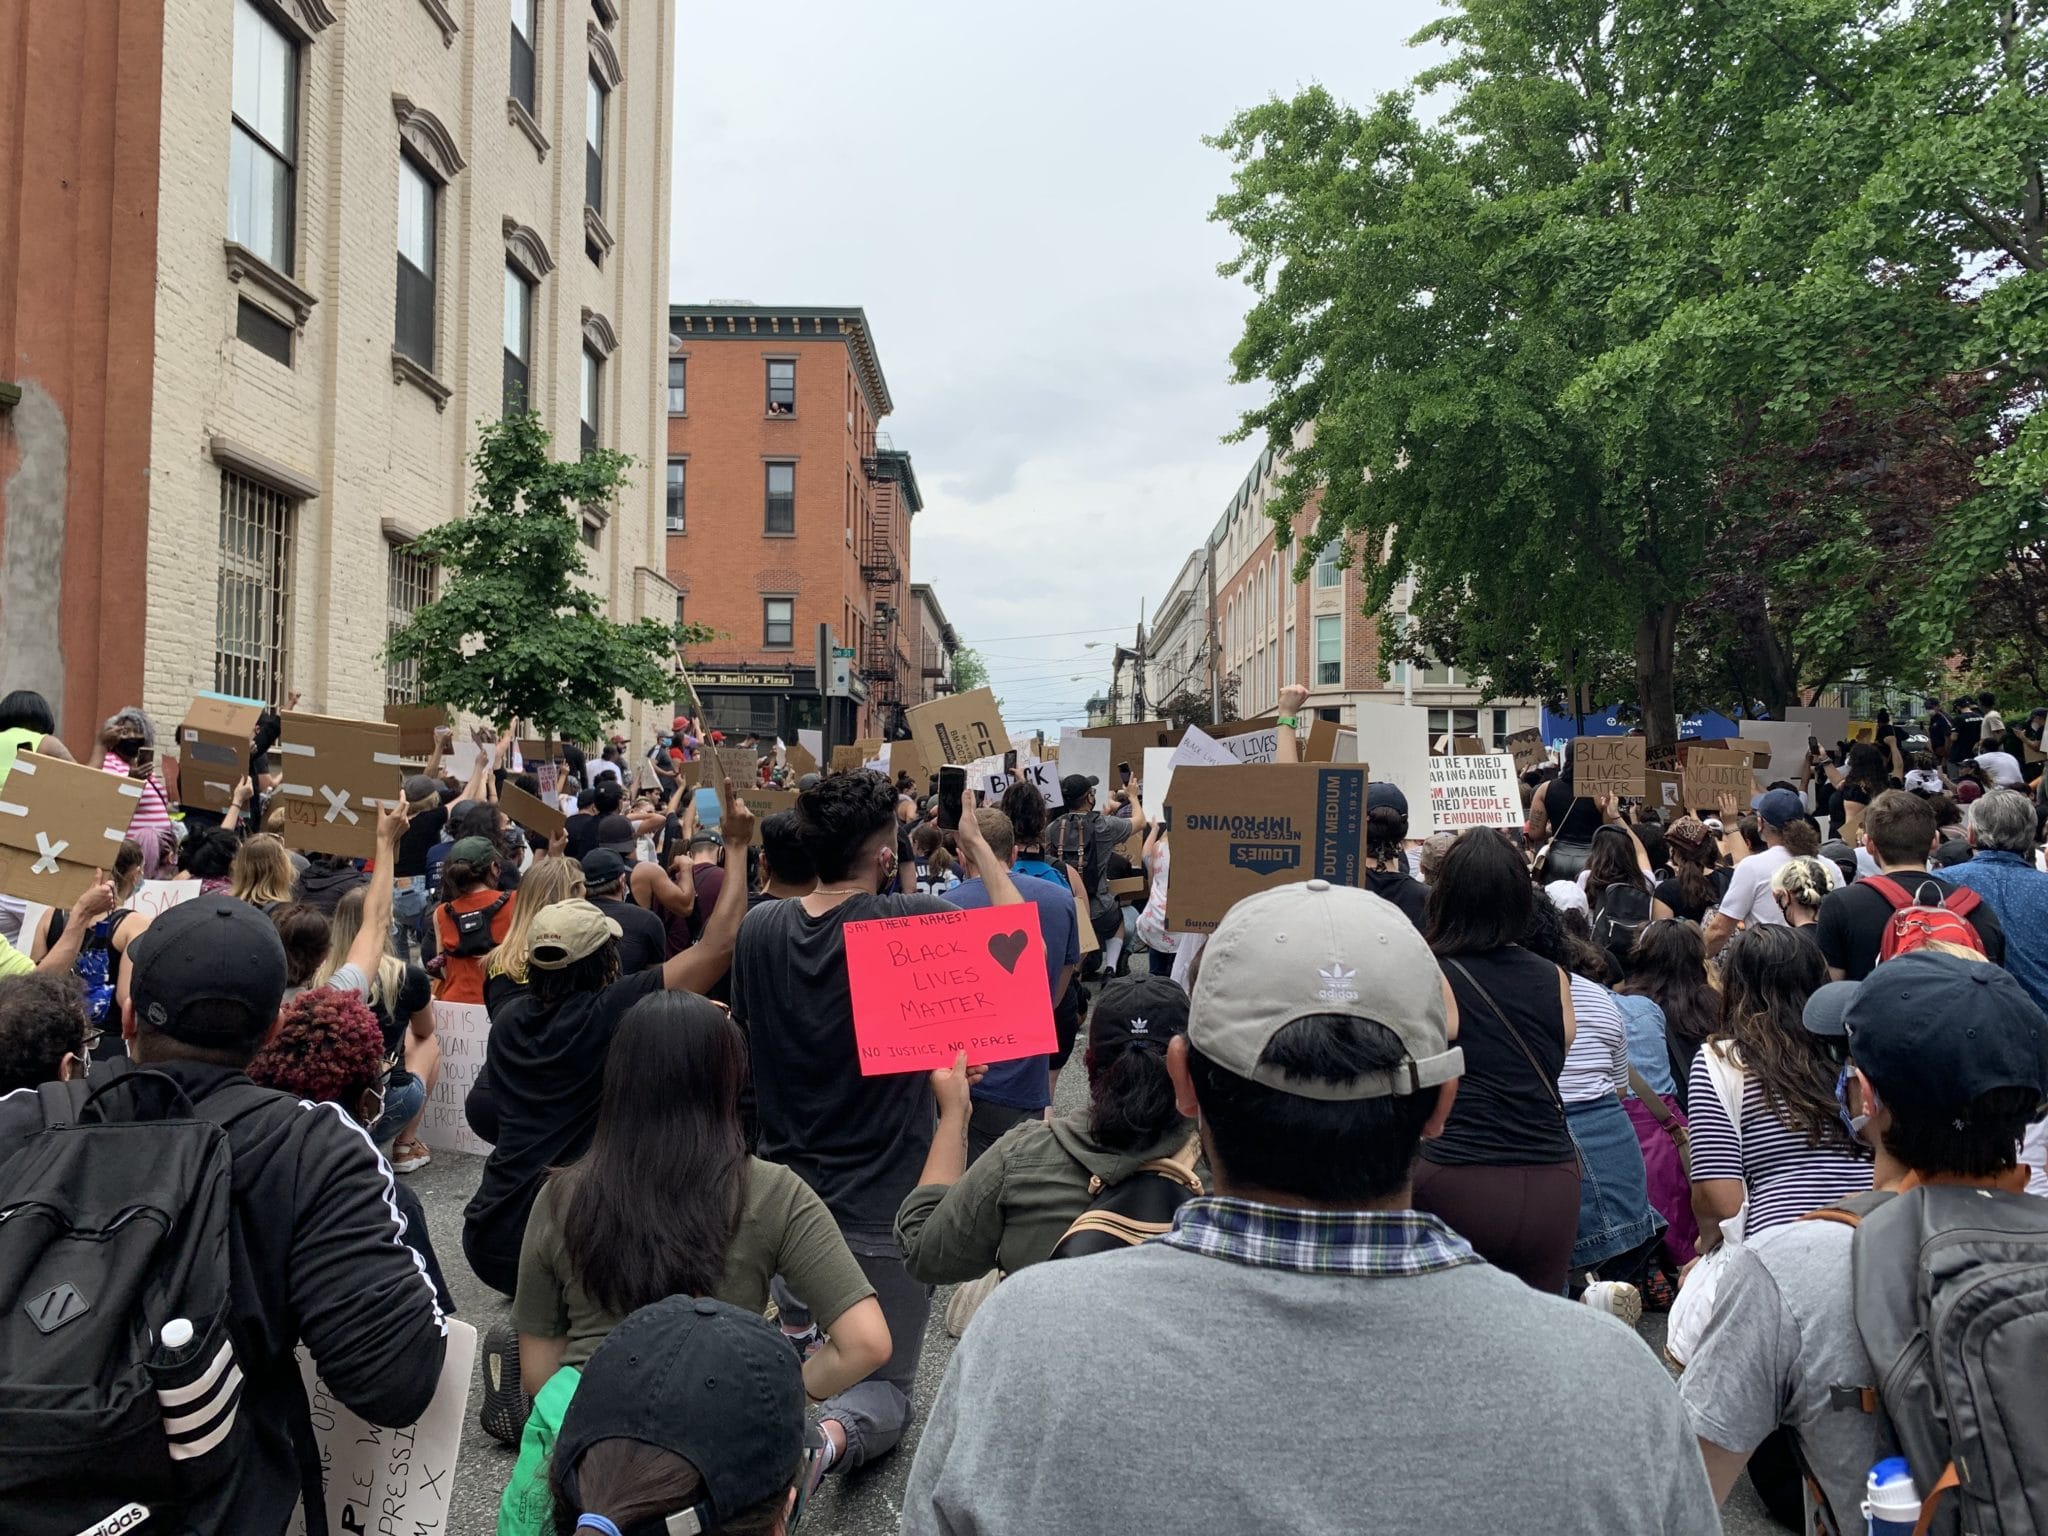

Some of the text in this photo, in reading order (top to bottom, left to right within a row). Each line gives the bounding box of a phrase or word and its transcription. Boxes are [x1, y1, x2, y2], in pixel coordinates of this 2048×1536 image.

[720, 675, 759, 684] Basille's
[763, 676, 790, 684] Pizza
[1243, 735, 1277, 757] LIVES
[1576, 743, 1640, 762] BLACK
[1464, 757, 1501, 769] TIRED
[1469, 768, 1507, 780] ABOUT
[1586, 764, 1632, 781] LIVES
[1685, 767, 1710, 784] NO
[1446, 785, 1497, 799] IMAGINE
[1580, 782, 1631, 796] MATTER
[1686, 787, 1710, 804] NO
[1463, 798, 1511, 810] PEOPLE
[1187, 815, 1291, 833] IMPROVING
[1322, 776, 1341, 876] DUTY MEDIUM
[1443, 812, 1503, 825] ENDURING
[1507, 811, 1517, 823] IT
[1231, 830, 1302, 840] NEVER STOP
[846, 911, 969, 933] SAY THEIR NAMES!
[886, 940, 968, 967] BLACK
[912, 966, 980, 991] LIVES
[1319, 988, 1360, 1000] adidas
[900, 992, 996, 1022] MATTER
[462, 1011, 475, 1033] IS
[862, 1034, 1018, 1059] NO JUSTICE, NO PEACE
[443, 1063, 466, 1080] YOU
[419, 1463, 447, 1501] X
